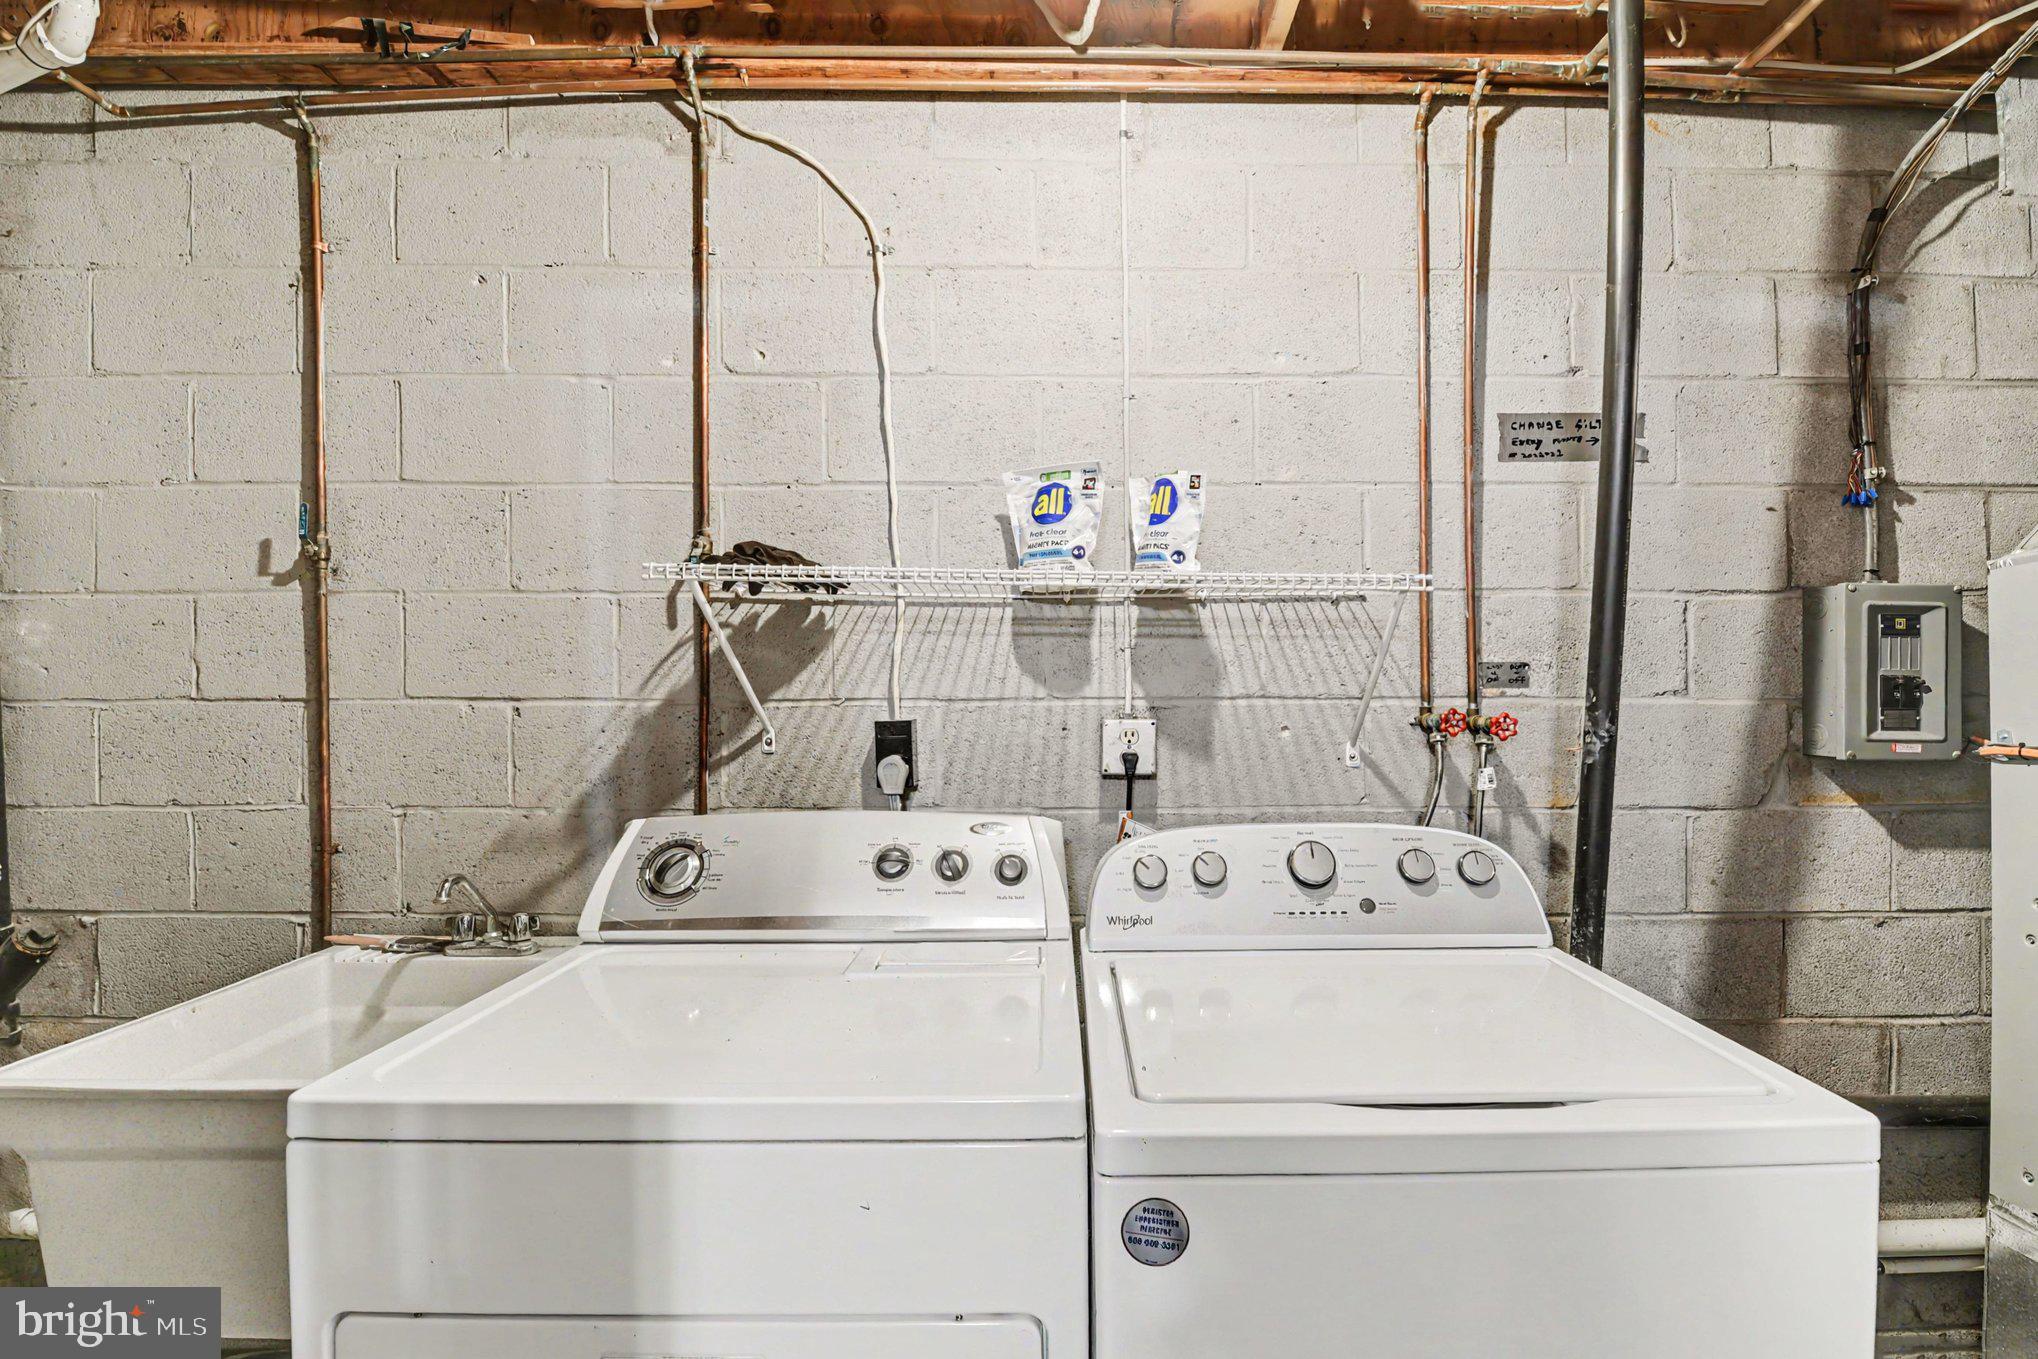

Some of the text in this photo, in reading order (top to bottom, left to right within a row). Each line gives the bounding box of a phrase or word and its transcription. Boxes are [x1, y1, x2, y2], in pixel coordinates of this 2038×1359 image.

[1511, 420, 1564, 431] CHANGE
[1034, 487, 1066, 516] all
[1106, 914, 1153, 930] Whirlpool
